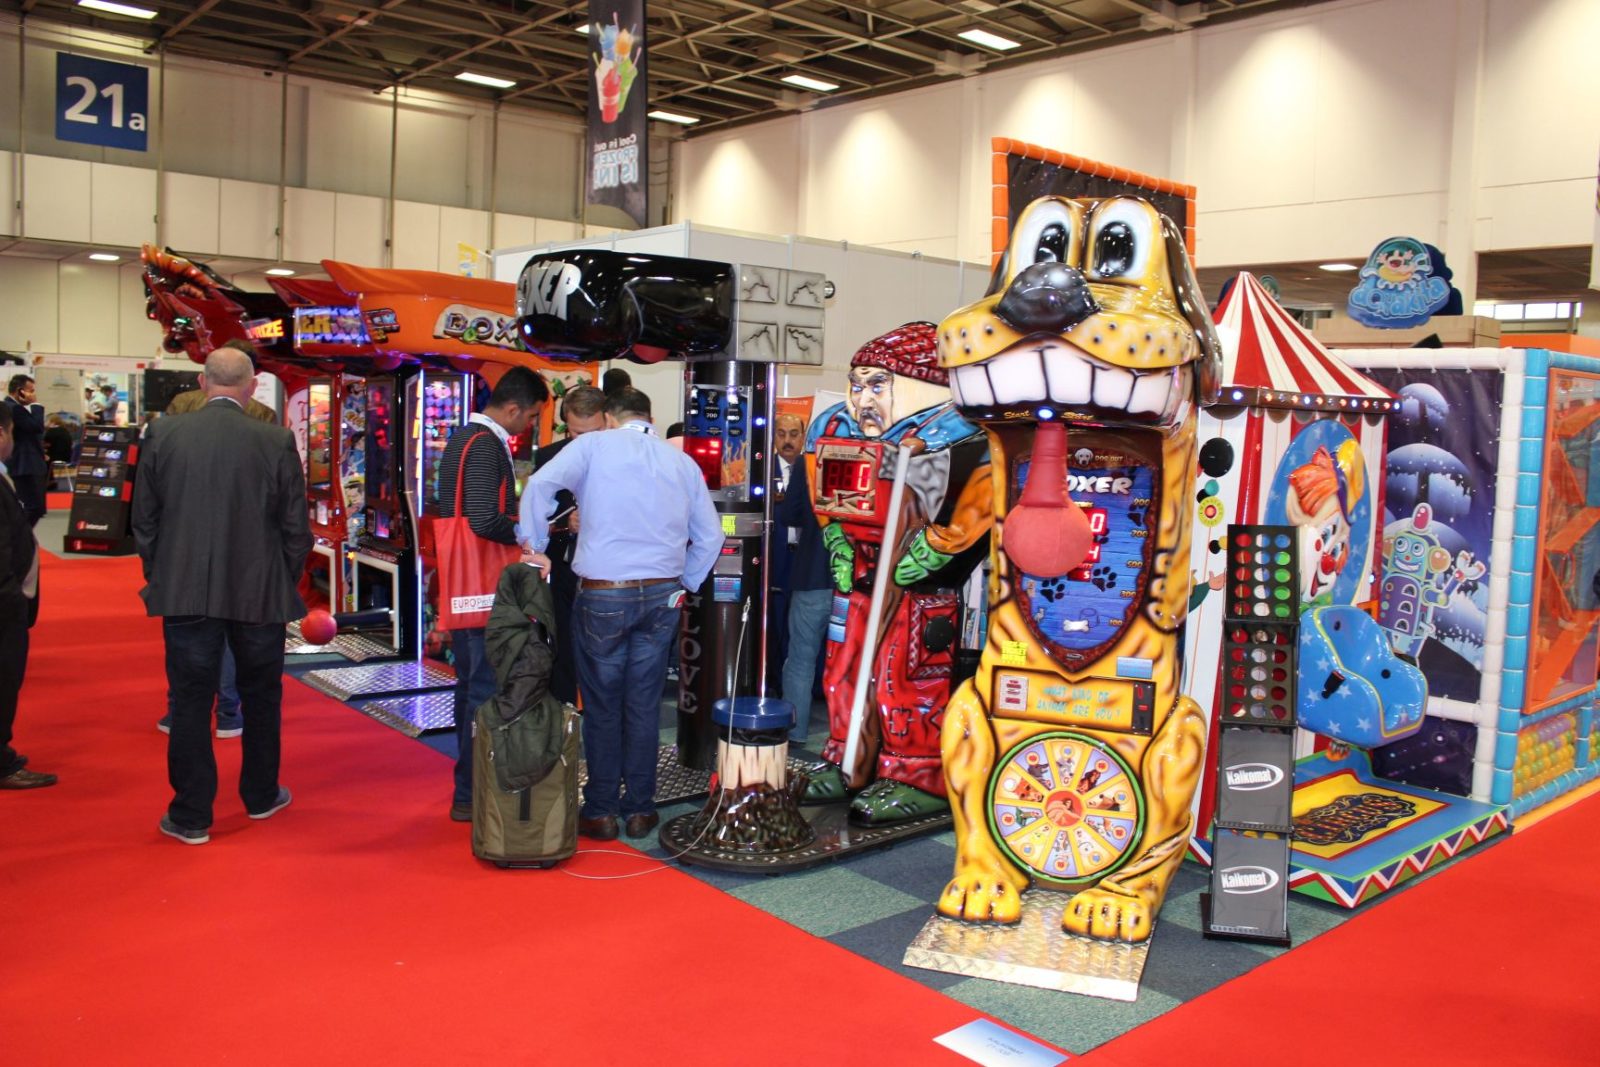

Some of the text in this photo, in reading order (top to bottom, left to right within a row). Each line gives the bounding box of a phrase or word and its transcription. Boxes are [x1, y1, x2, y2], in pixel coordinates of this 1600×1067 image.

[65, 76, 146, 131] 21a
[1003, 410, 1031, 419] Start
[1066, 474, 1133, 495] OXER
[1090, 513, 1105, 533] 0
[1132, 528, 1148, 538] 700
[1127, 560, 1143, 568] 500
[1226, 769, 1272, 786] Kalkomat
[1221, 872, 1267, 889] Kalkomat
